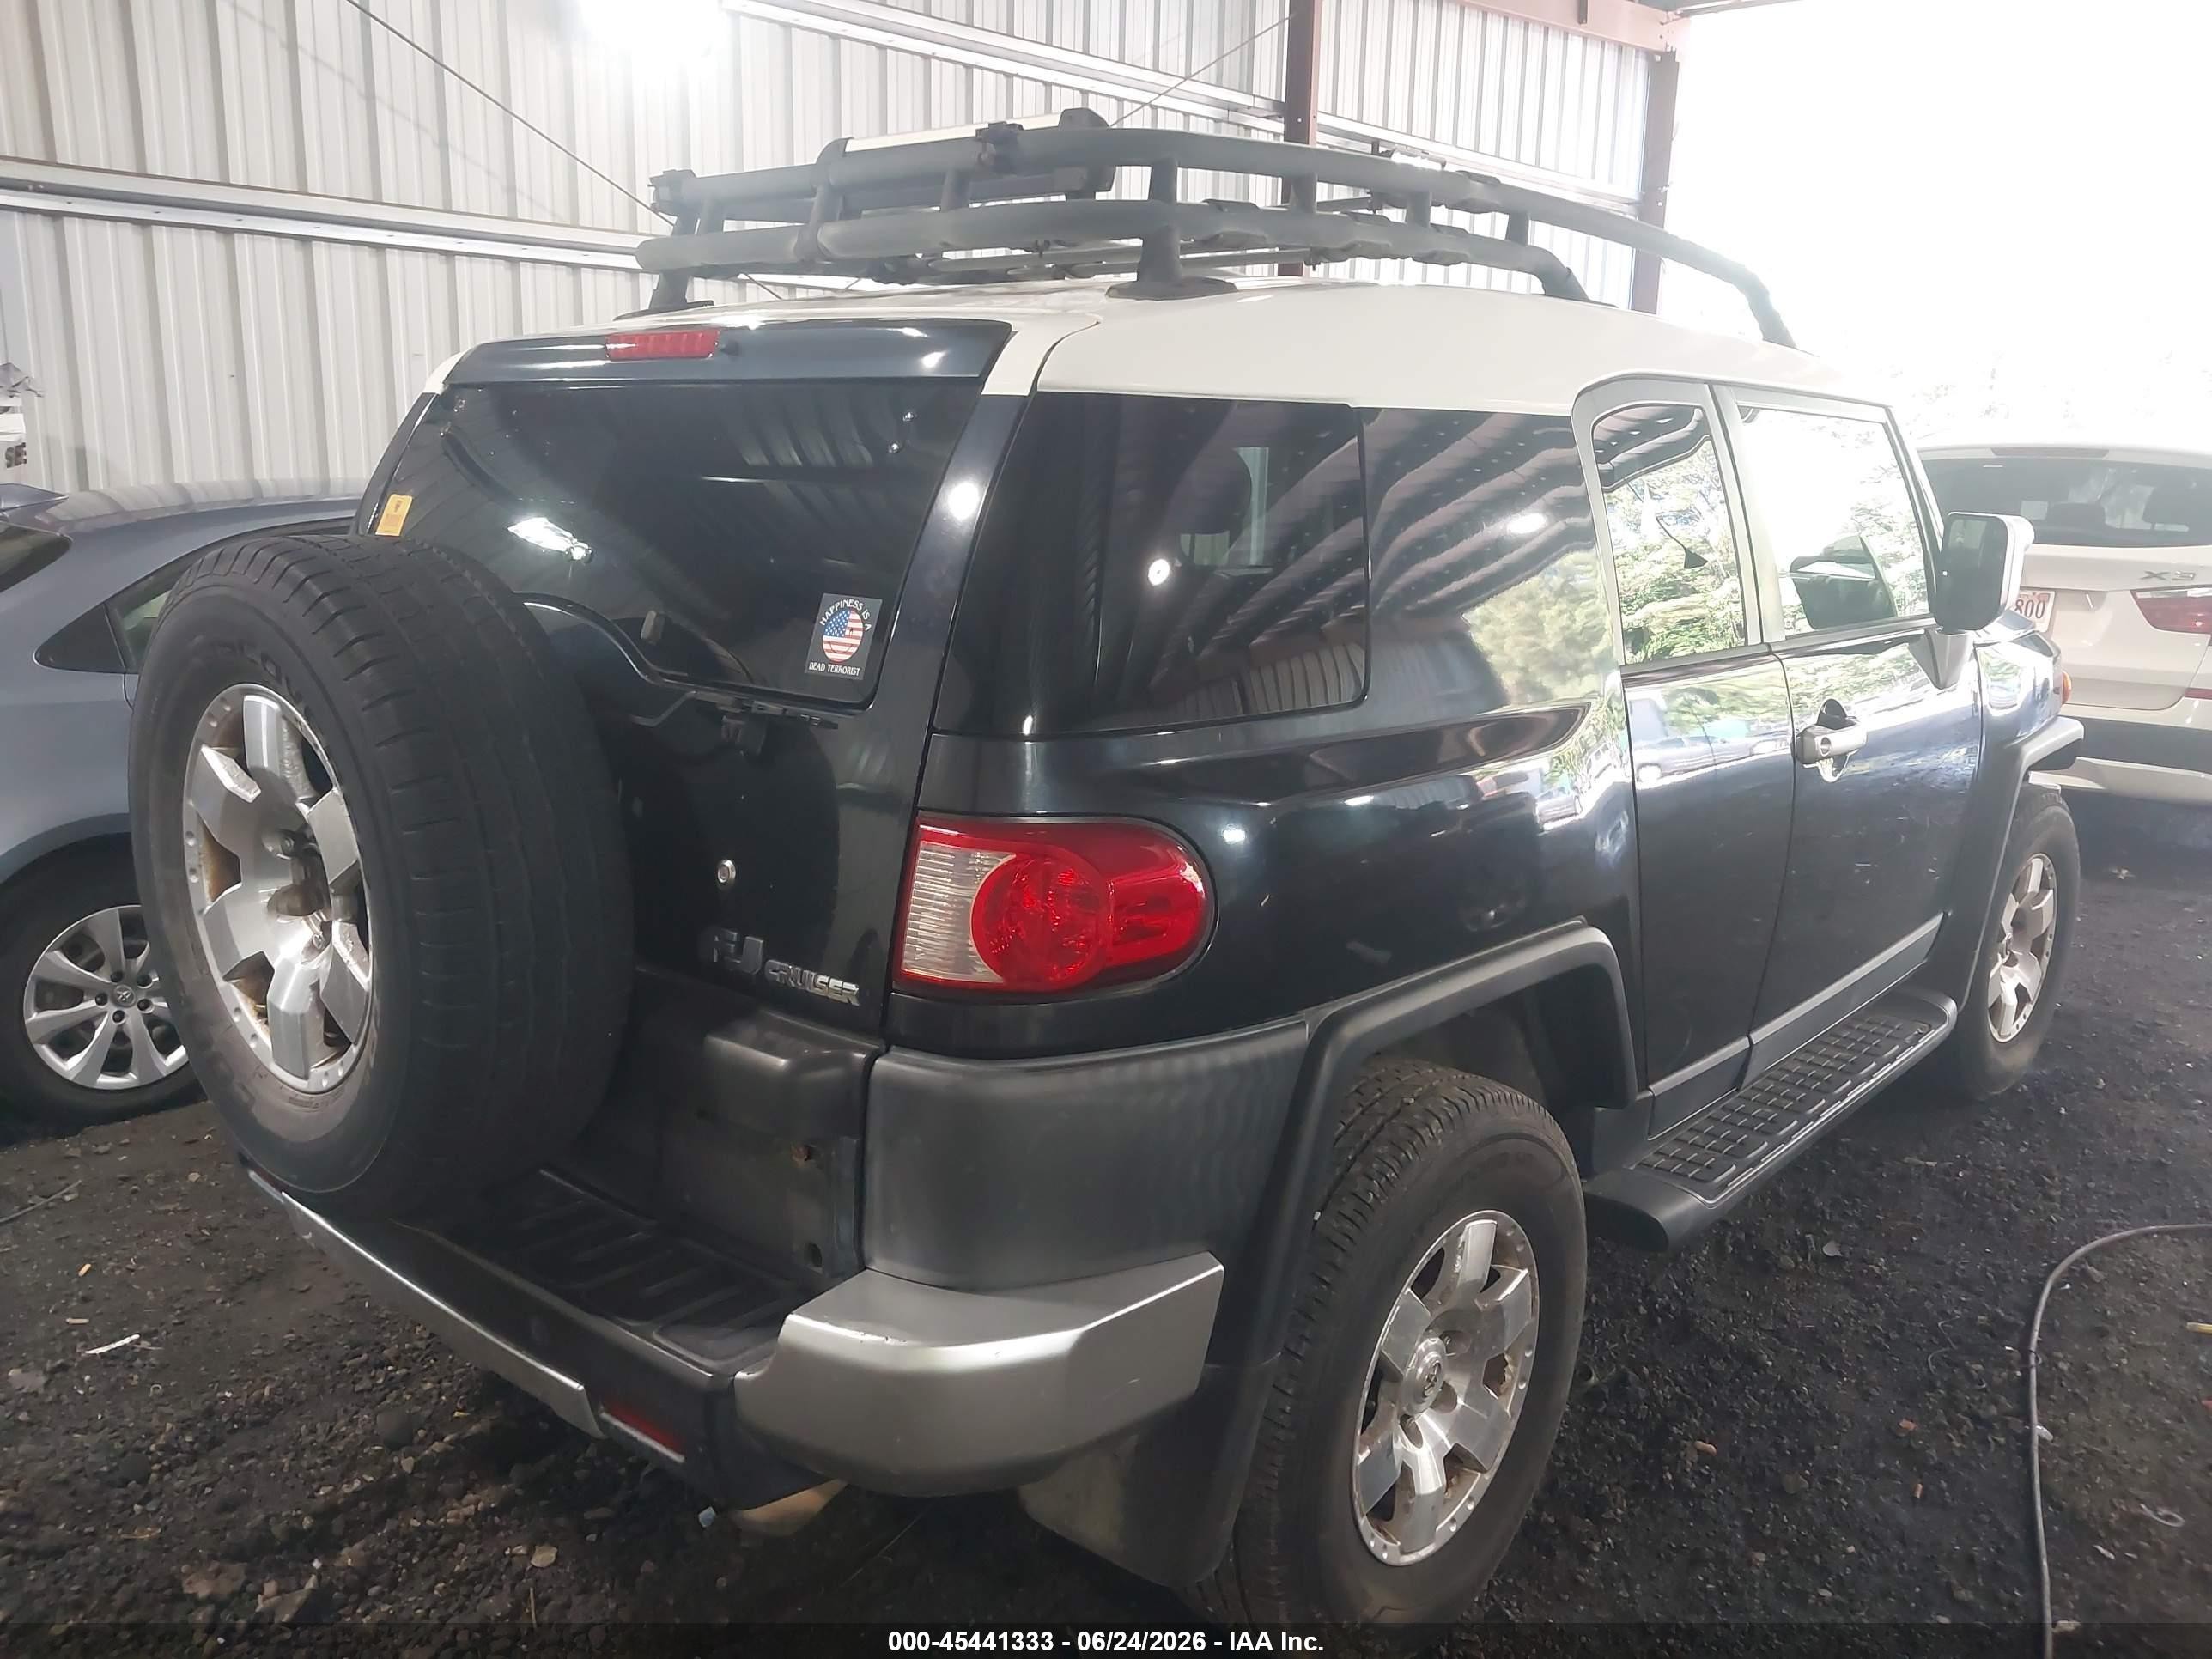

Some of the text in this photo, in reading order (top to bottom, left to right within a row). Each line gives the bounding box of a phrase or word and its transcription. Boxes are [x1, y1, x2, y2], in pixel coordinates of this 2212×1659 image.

[2139, 570, 2197, 581] X3
[819, 599, 872, 632] HAPPINESS IS A
[809, 661, 861, 677] DEAD TERRORIST
[713, 927, 860, 1006] FJ CRUISER
